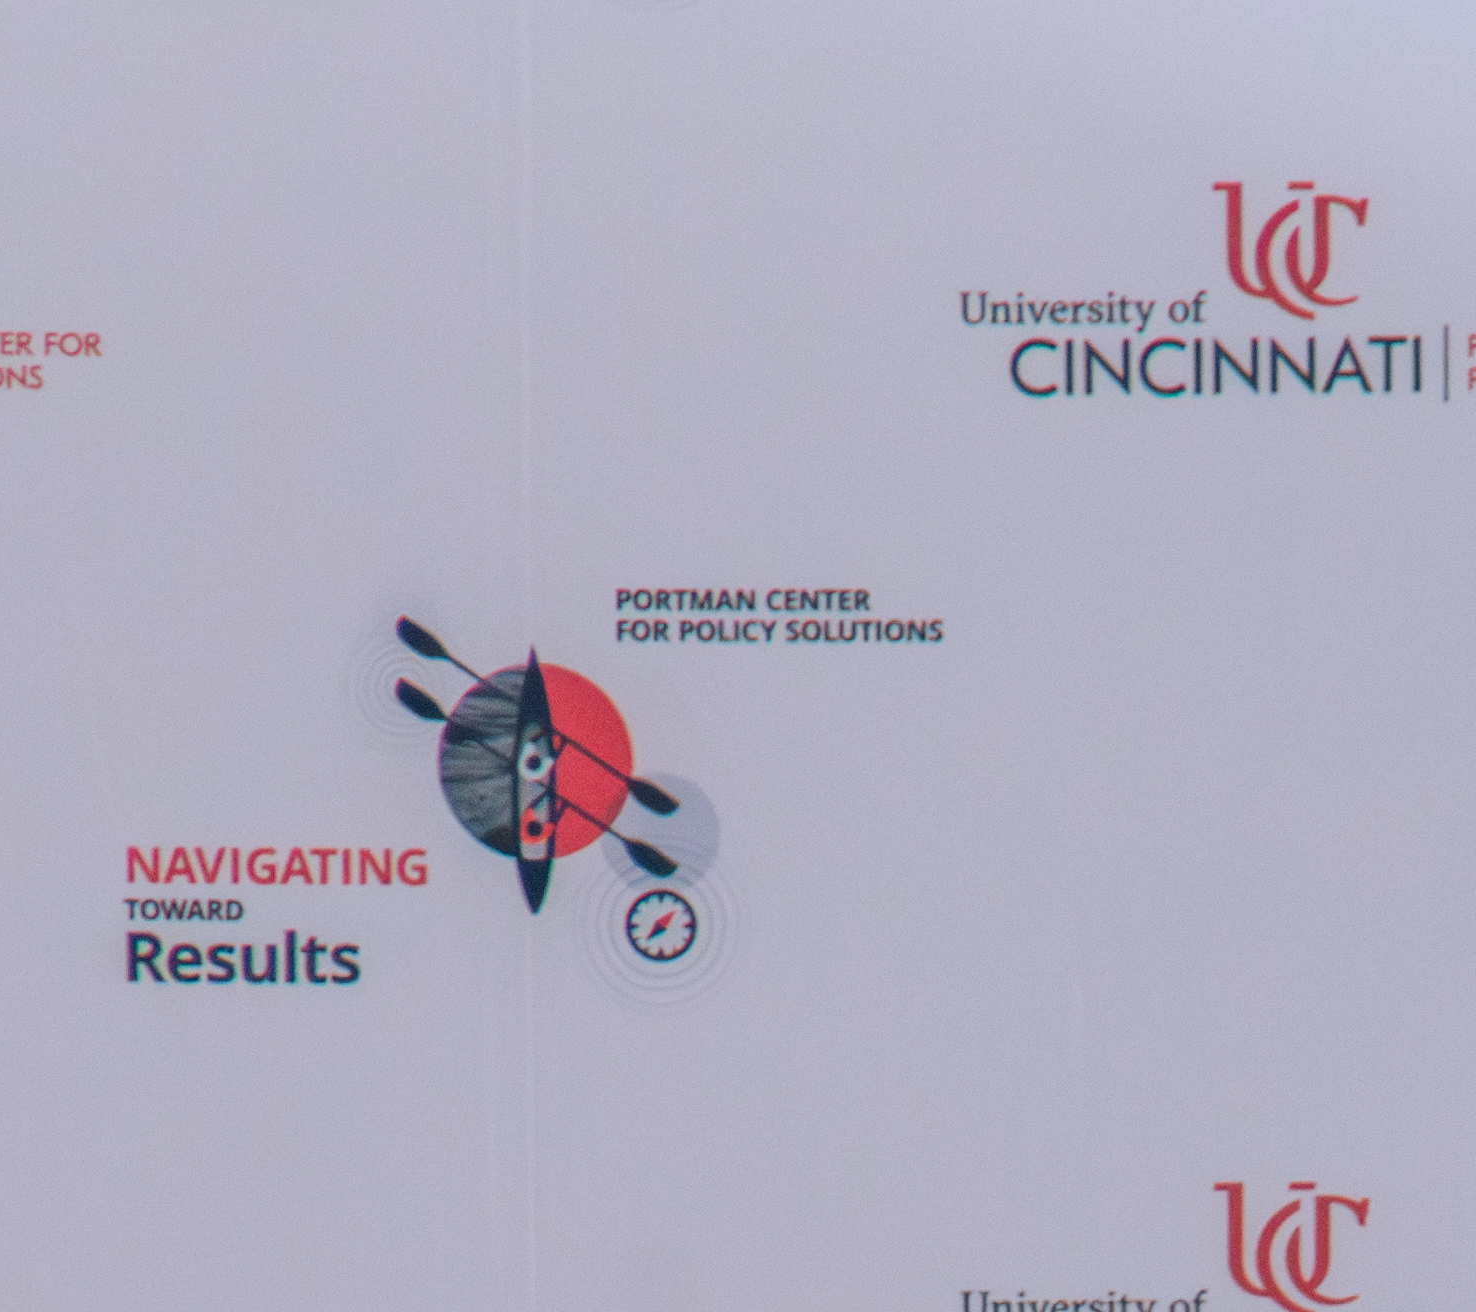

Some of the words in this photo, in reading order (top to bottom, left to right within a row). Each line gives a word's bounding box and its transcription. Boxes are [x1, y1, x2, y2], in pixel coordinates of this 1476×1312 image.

[959, 289, 1156, 333] University
[1168, 288, 1208, 325] of
[42, 331, 103, 358] FOR
[1009, 336, 1423, 400] CINCINNATI
[615, 588, 756, 614] PORTMAN
[766, 588, 871, 613] CENTER
[615, 619, 670, 644] FOR
[678, 619, 777, 644] POLICY
[785, 618, 944, 644] SOLUTIONS
[126, 846, 429, 887] NAVIGATING
[124, 897, 245, 923] TOWARD
[126, 928, 362, 986] Results
